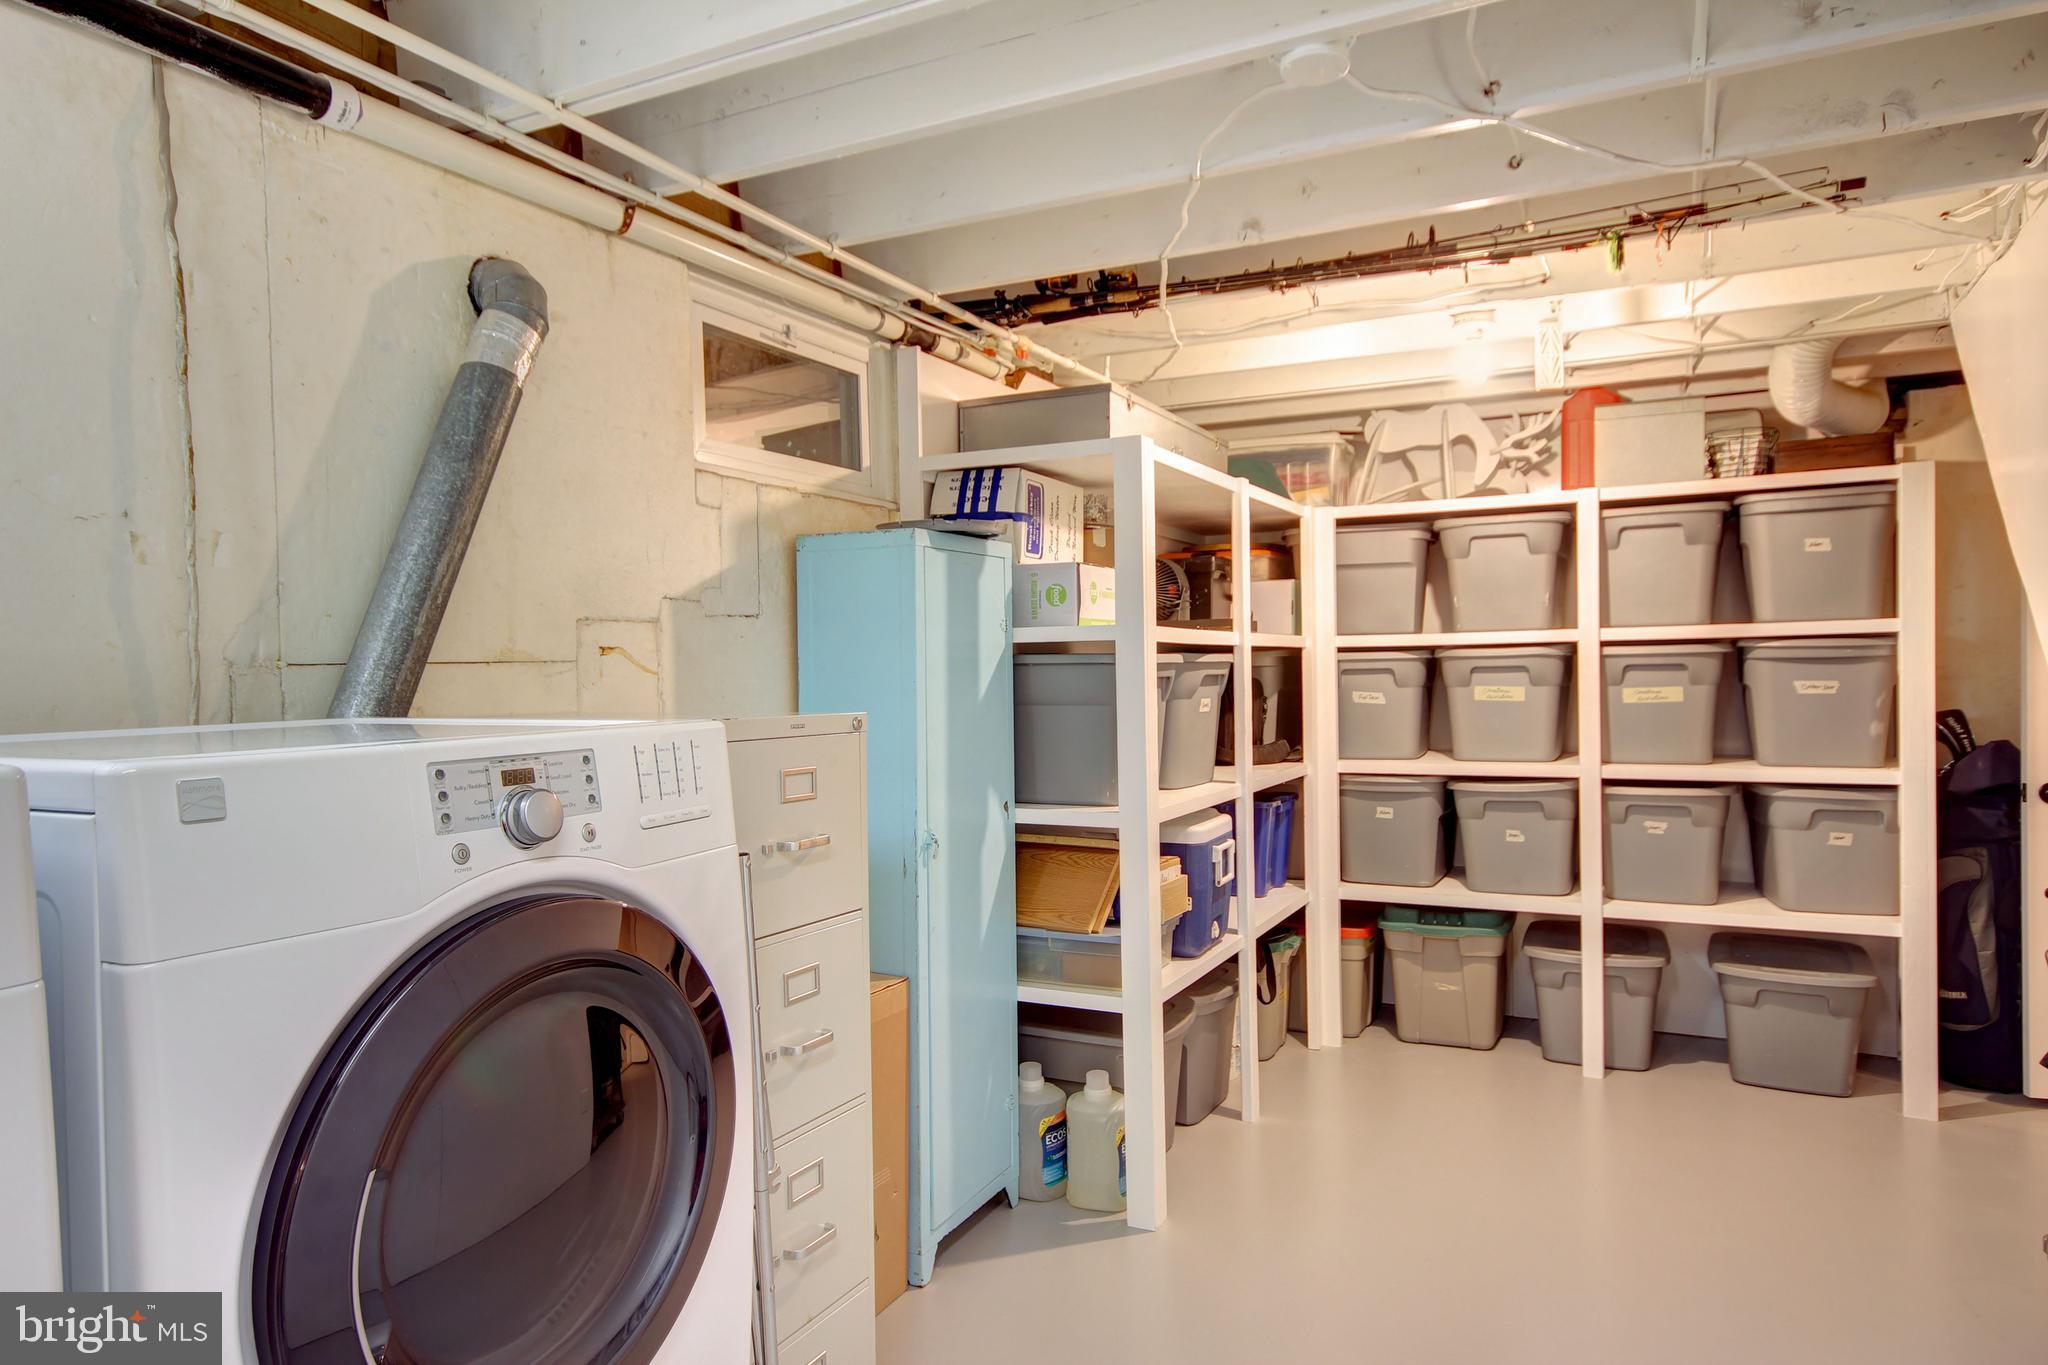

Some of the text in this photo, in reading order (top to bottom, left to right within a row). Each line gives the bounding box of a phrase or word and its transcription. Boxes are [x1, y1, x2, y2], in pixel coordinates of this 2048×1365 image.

[1050, 584, 1066, 608] food
[454, 866, 472, 874] POWER
[1045, 1128, 1067, 1146] ECOS
